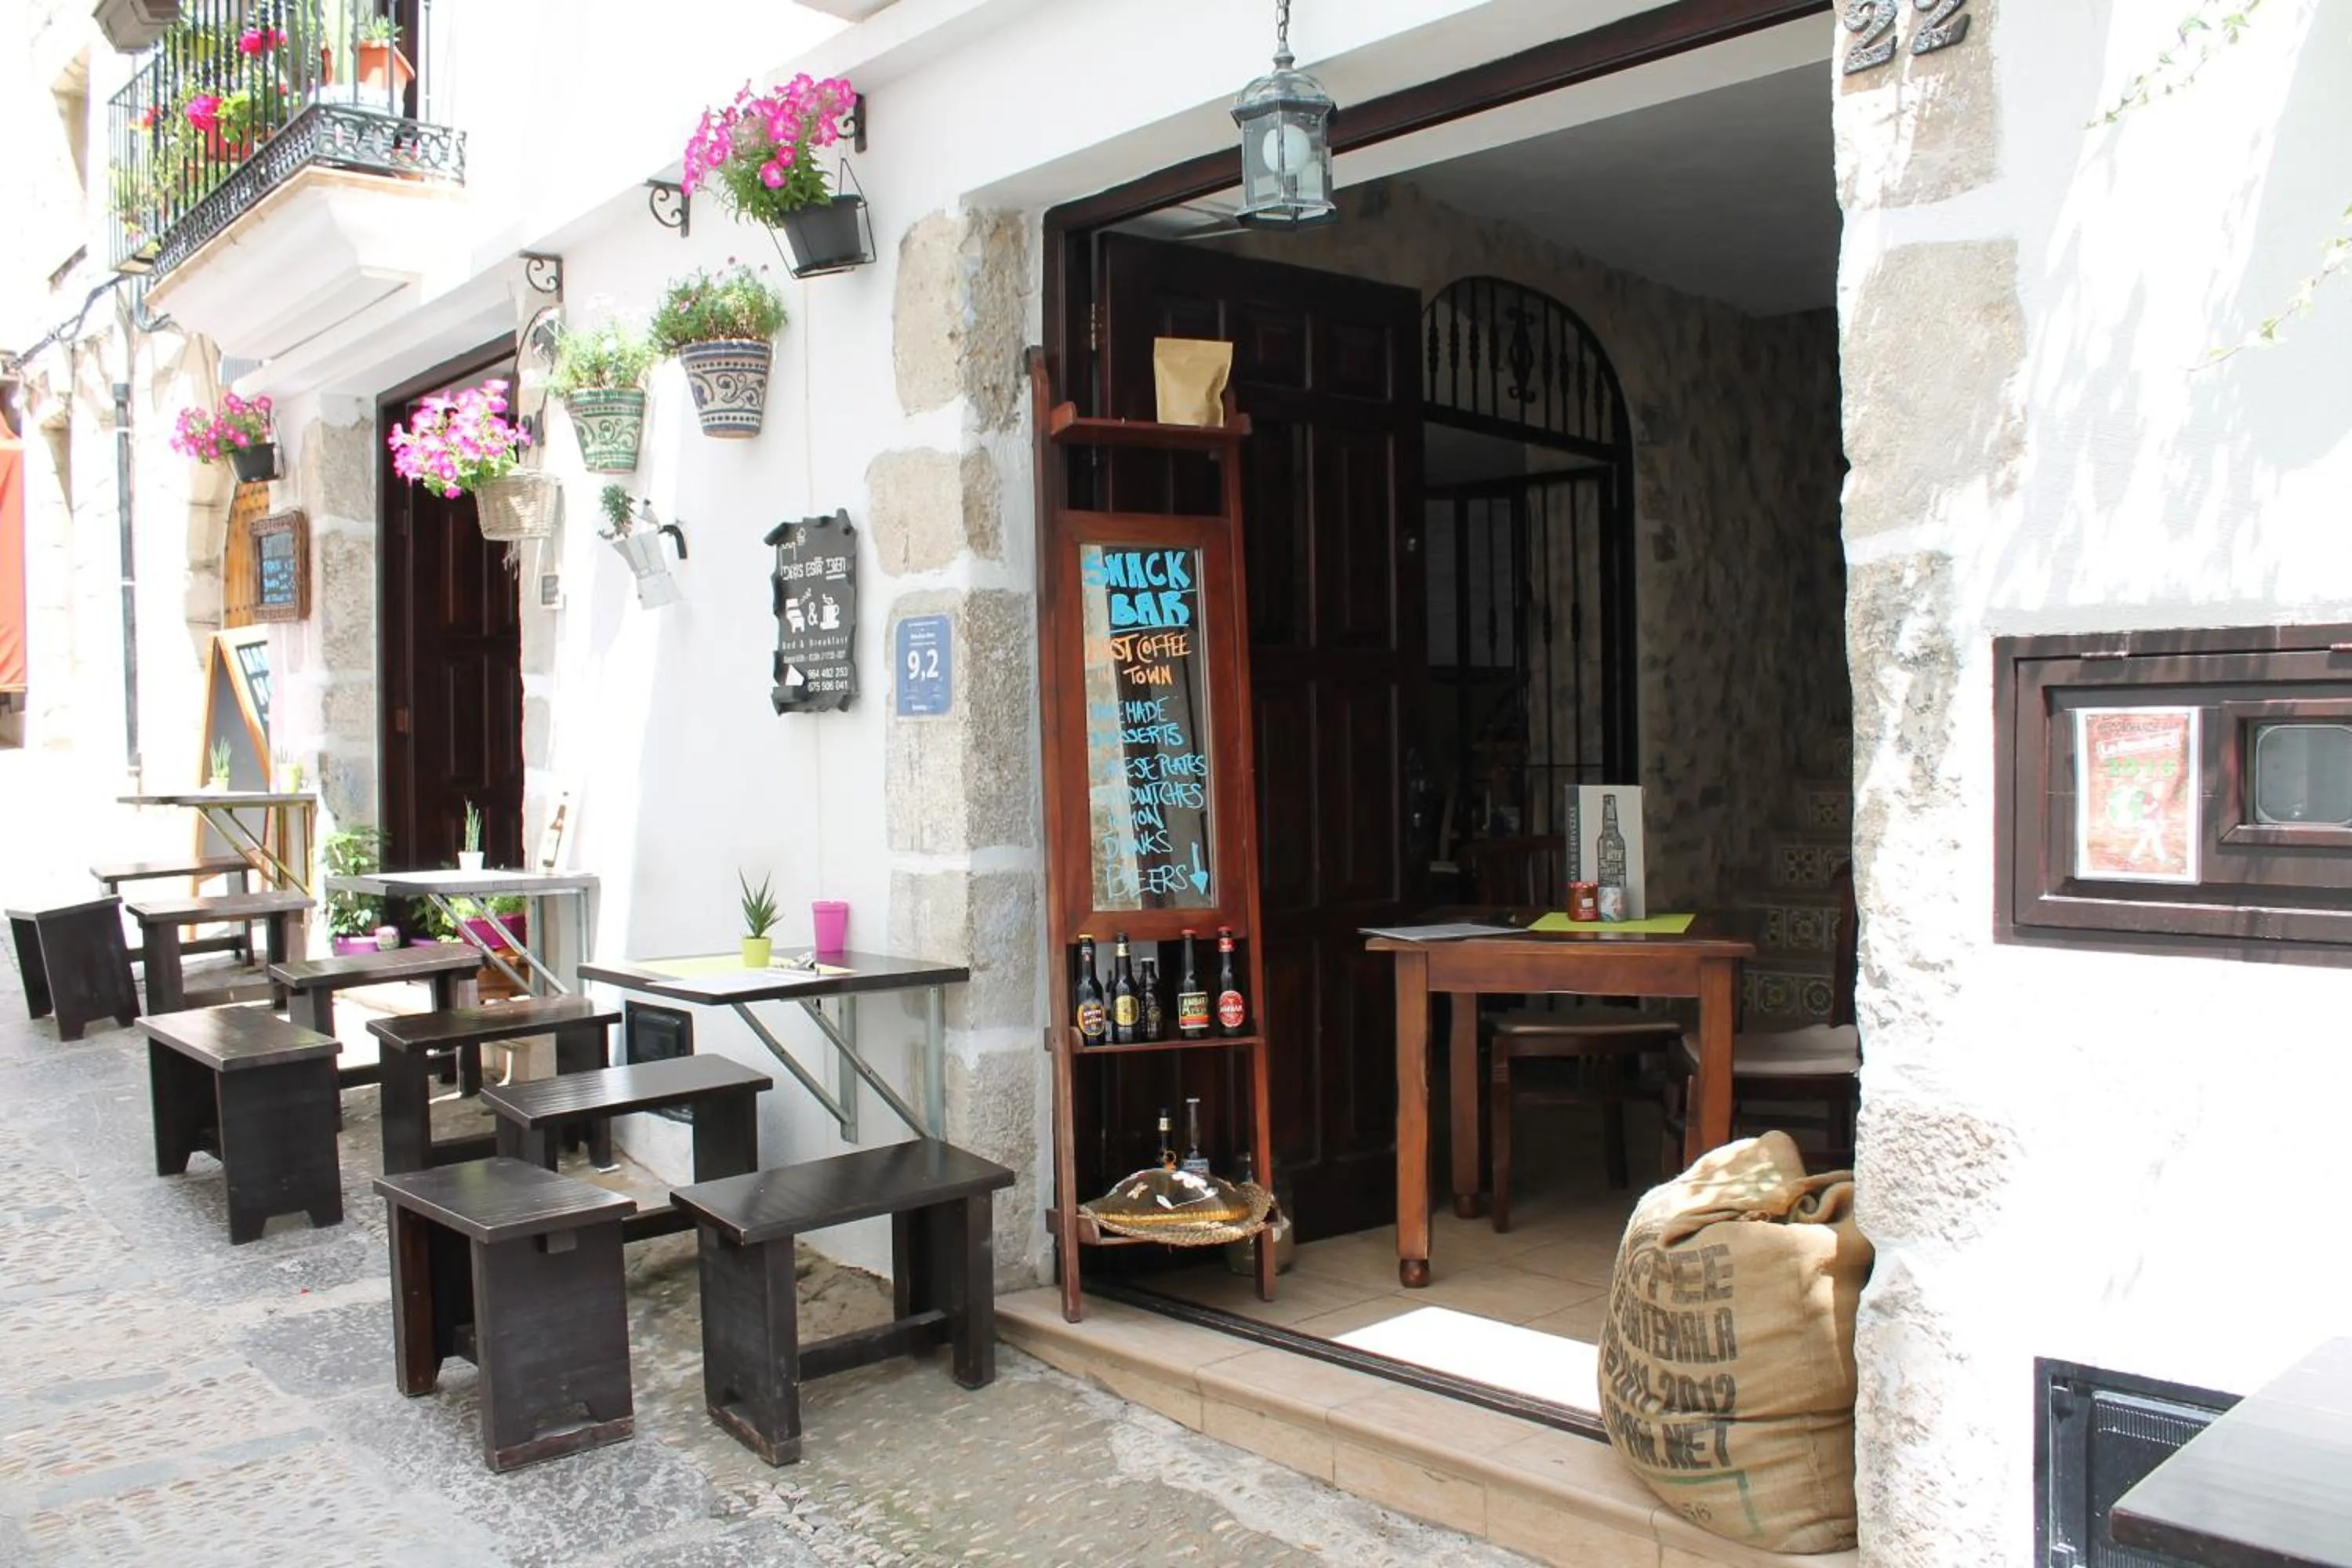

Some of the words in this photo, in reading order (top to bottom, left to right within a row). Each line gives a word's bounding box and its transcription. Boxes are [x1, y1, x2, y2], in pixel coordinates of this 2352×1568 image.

[1083, 551, 1191, 590] SNACK
[1110, 590, 1191, 627] BAR
[808, 635, 848, 648] Breakfast
[1137, 633, 1192, 663] COFFEE
[907, 648, 939, 681] 9,2
[1123, 665, 1173, 686] TOWN
[1154, 753, 1208, 778] PLATES
[1104, 830, 1174, 855] DNKS
